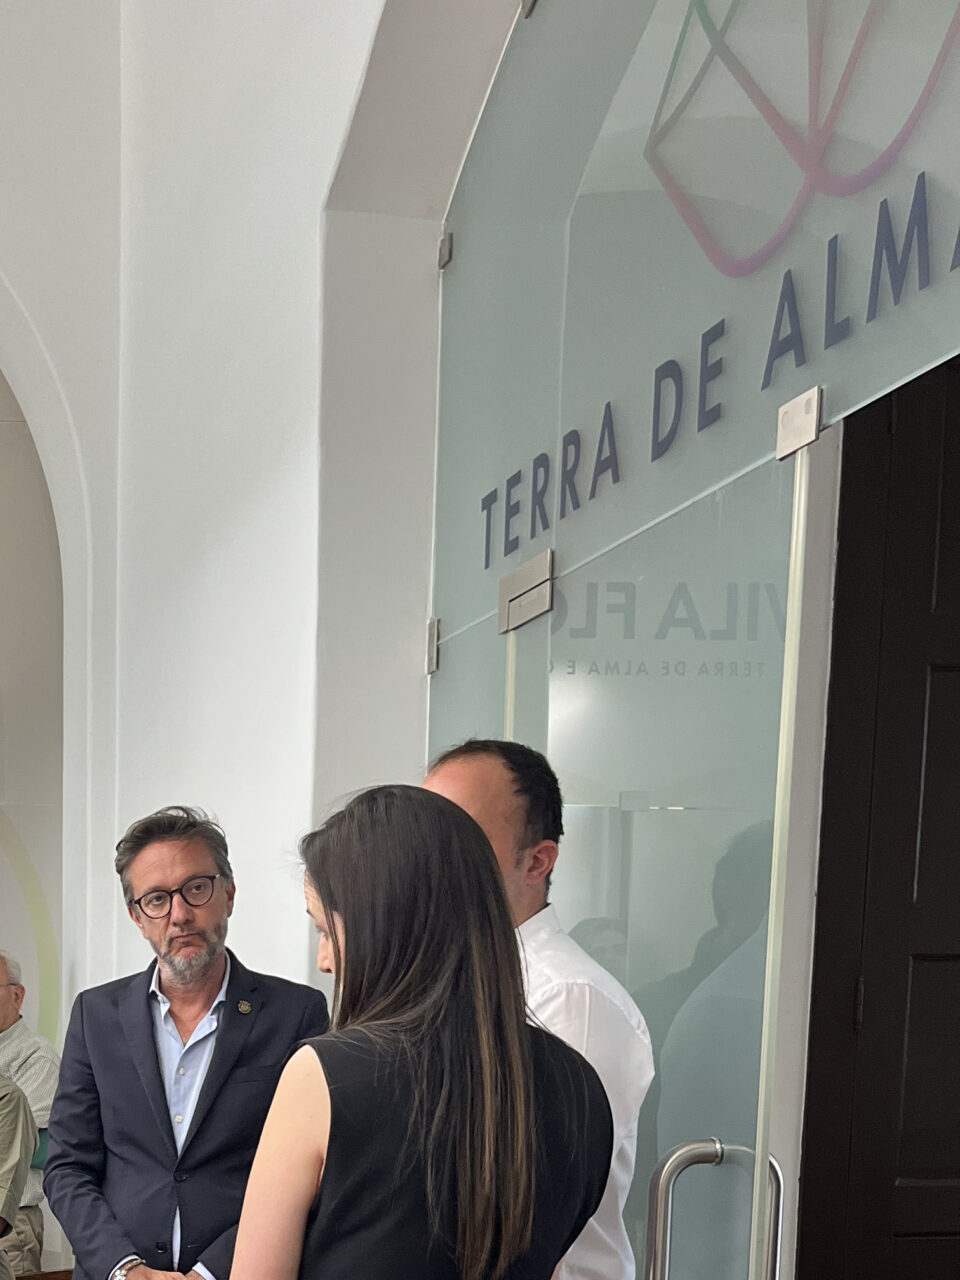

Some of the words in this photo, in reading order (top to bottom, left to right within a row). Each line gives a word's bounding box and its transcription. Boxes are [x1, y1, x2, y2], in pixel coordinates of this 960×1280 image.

[481, 401, 620, 570] TERRA
[651, 318, 725, 462] DE
[761, 170, 960, 391] ALM
